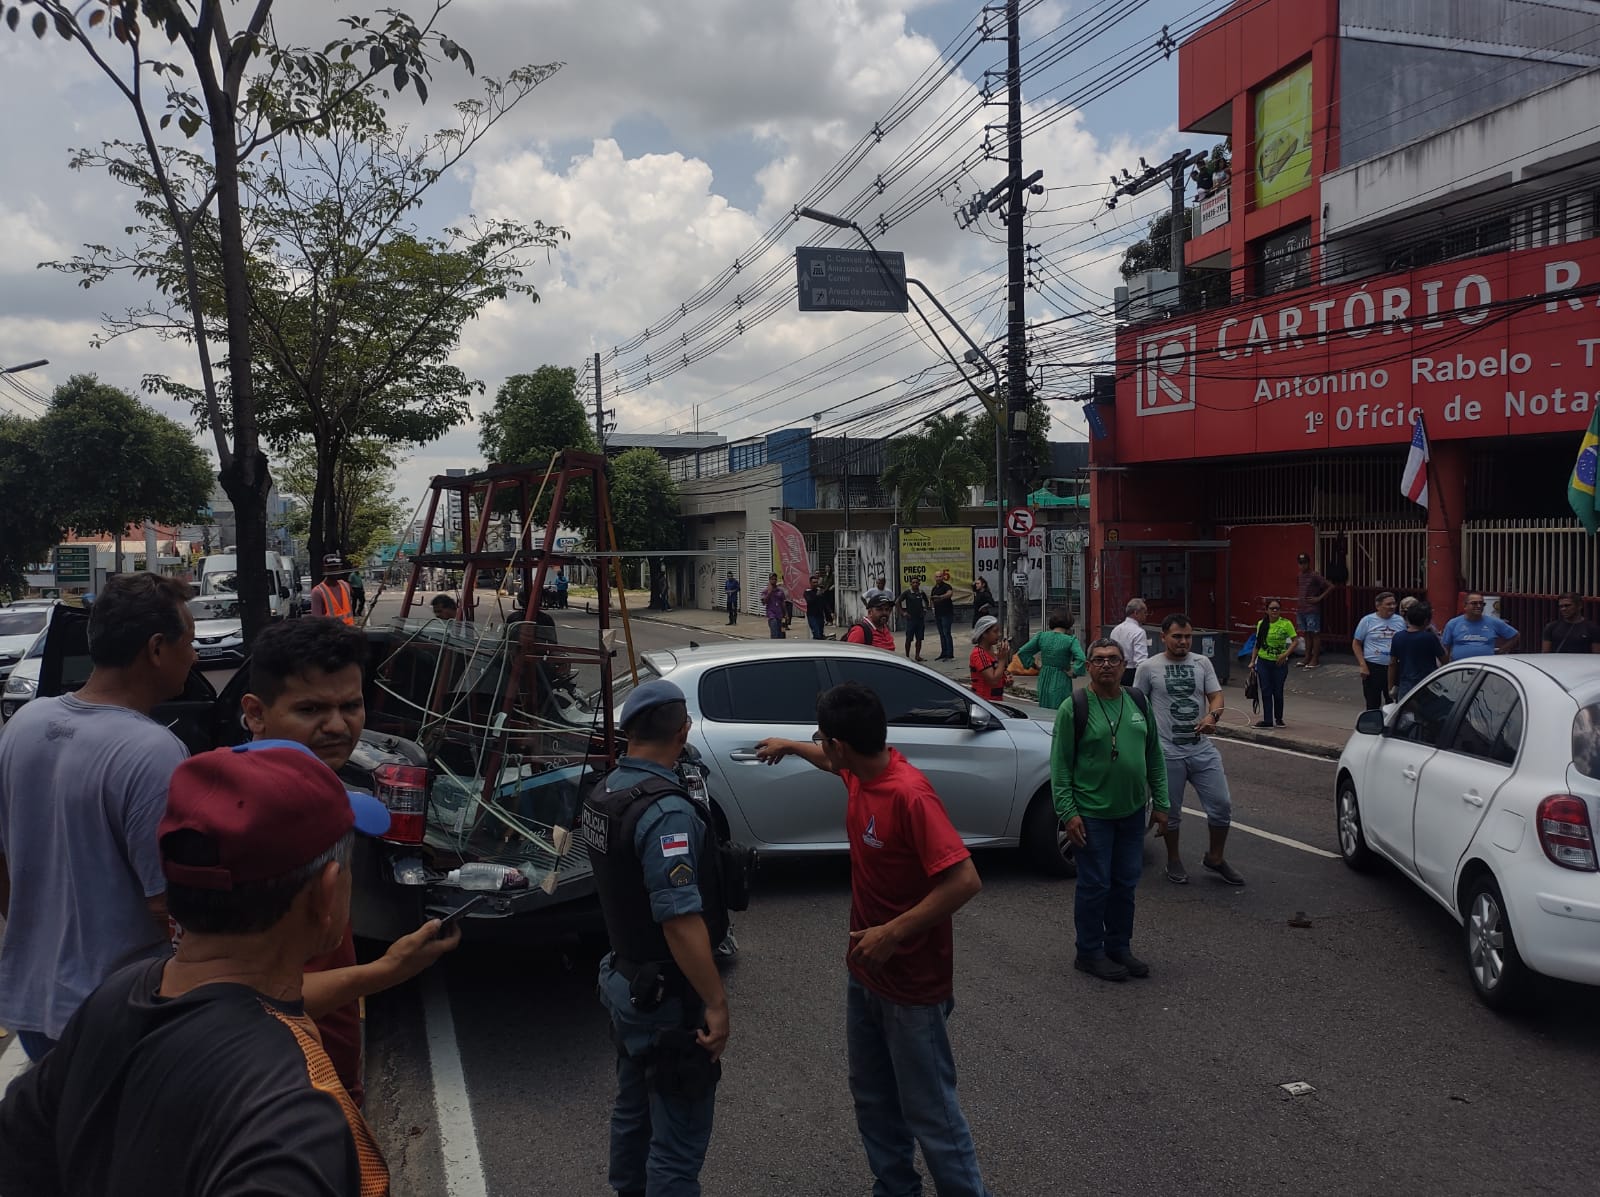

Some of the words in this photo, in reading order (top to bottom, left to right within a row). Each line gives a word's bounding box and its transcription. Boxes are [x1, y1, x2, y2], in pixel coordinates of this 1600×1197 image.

[1217, 274, 1492, 361] CARTÓRIO
[1545, 260, 1600, 314] R
[1253, 368, 1389, 403] Antonino
[1411, 348, 1532, 385] Rabelo
[1335, 402, 1424, 431] Ofício
[1443, 394, 1482, 422] de
[903, 565, 926, 575] PREÇO
[1164, 664, 1195, 679] JUST
